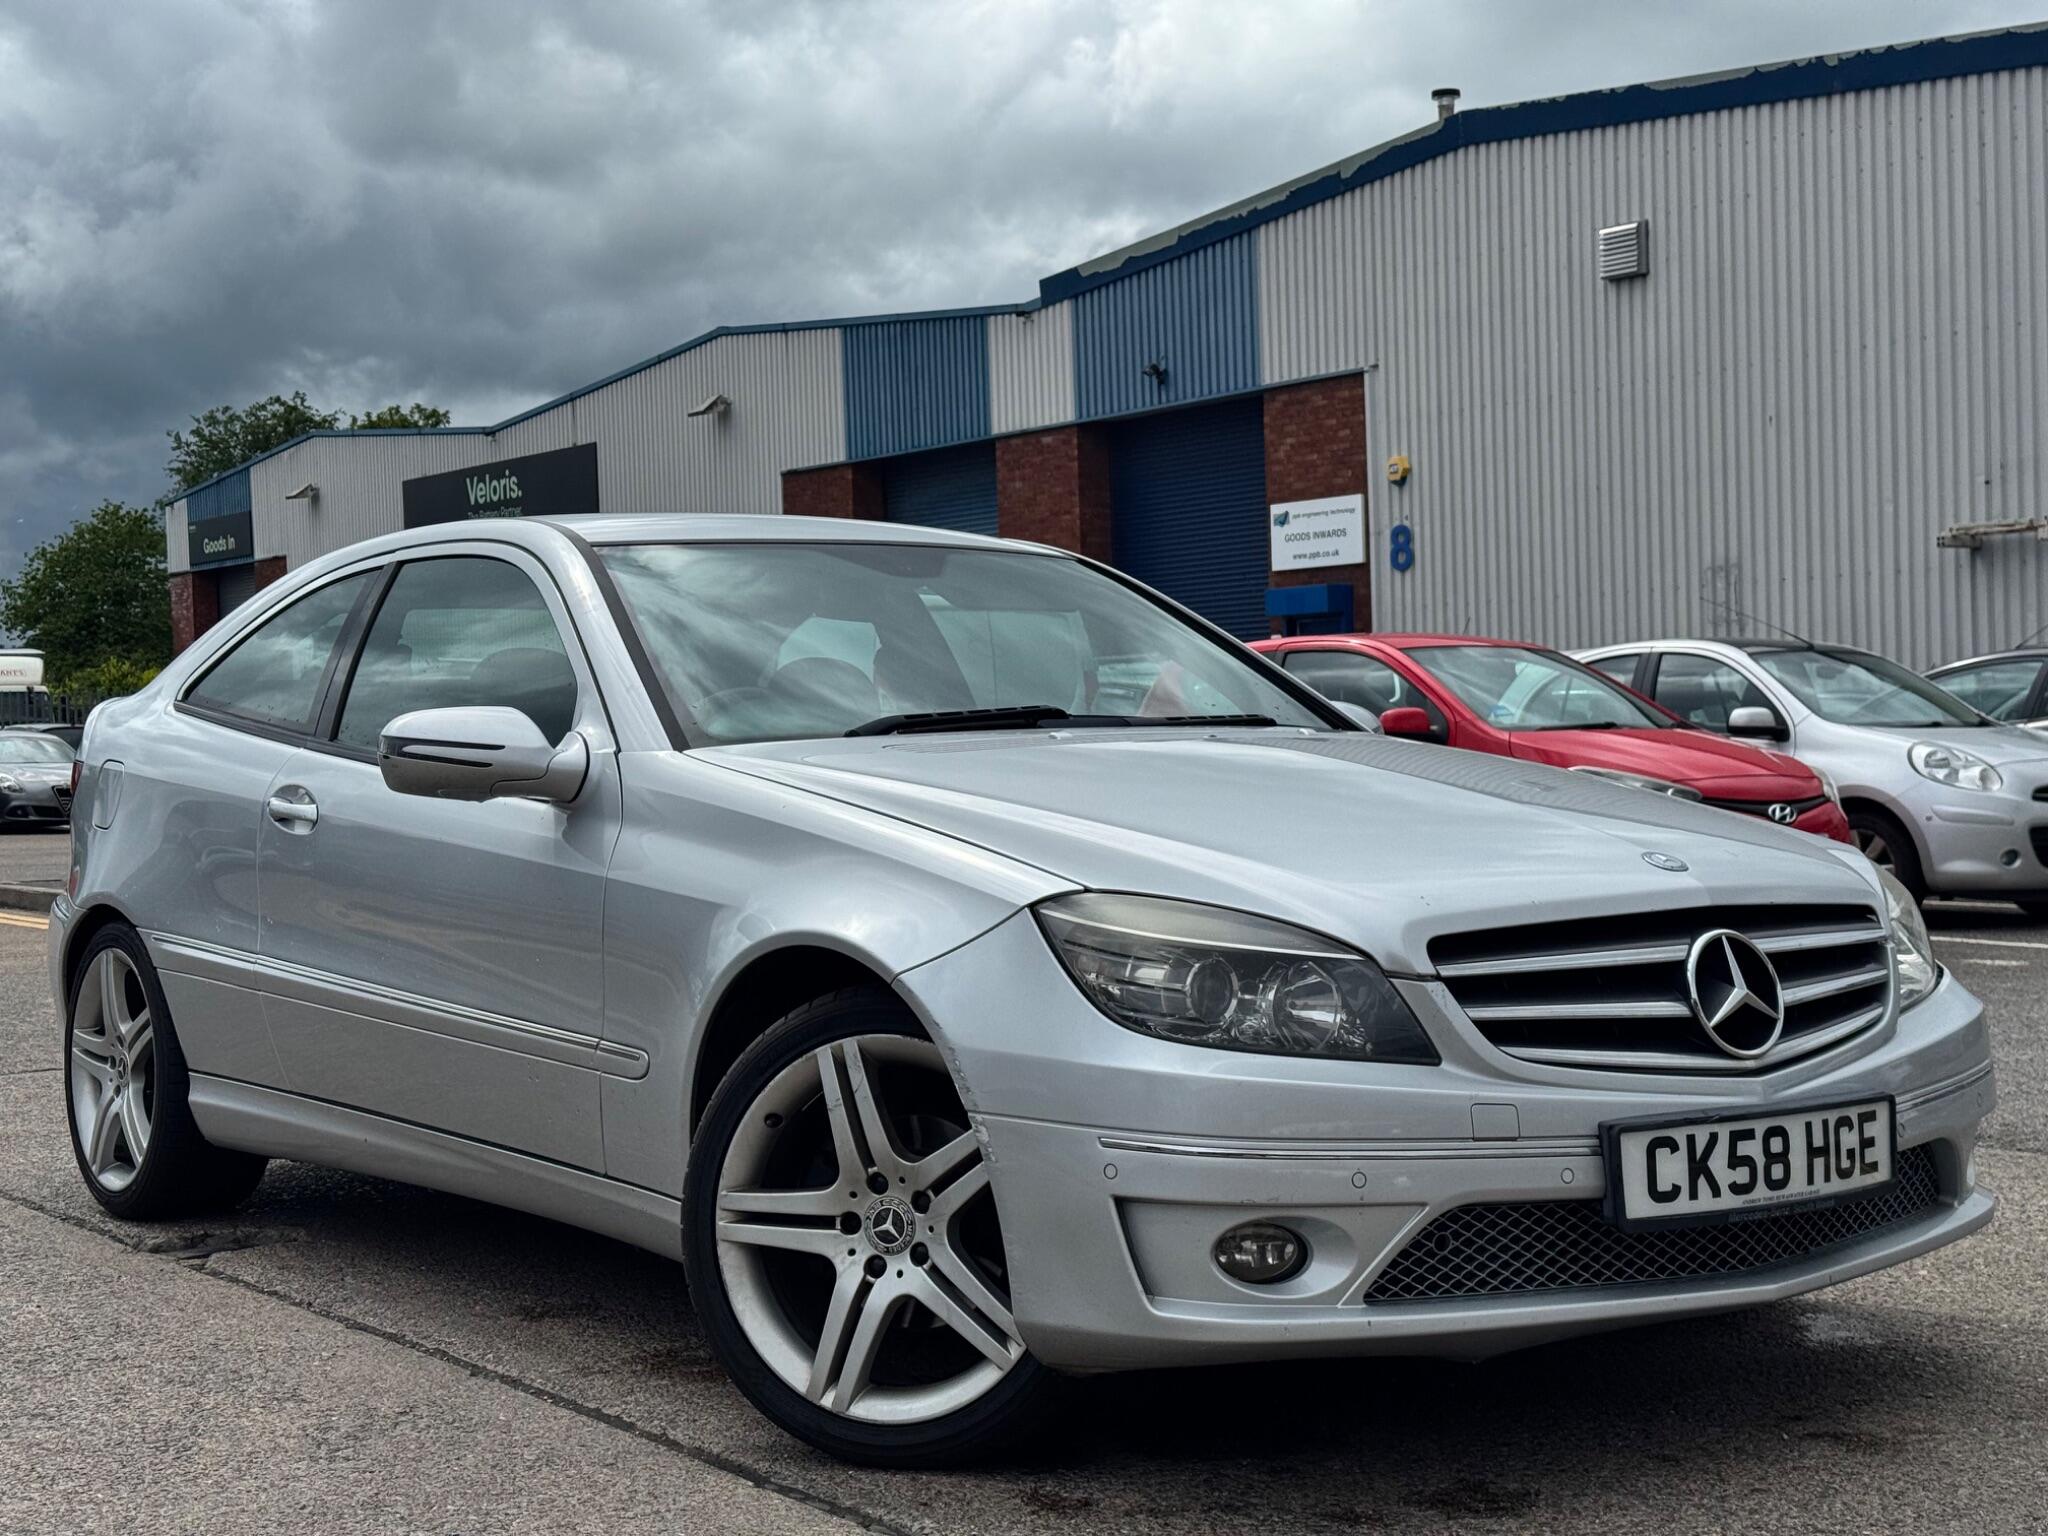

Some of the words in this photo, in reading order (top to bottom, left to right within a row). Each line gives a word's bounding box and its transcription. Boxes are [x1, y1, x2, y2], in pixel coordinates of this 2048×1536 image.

[466, 469, 522, 505] Veloris.
[203, 536, 227, 554] Goods
[227, 534, 236, 551] In
[1284, 531, 1311, 542] GOODS
[1312, 528, 1347, 540] INWARDS
[1390, 524, 1413, 572] 8
[1292, 549, 1339, 560] www.ppb.co.uk
[1645, 1124, 1791, 1204] CK58
[1804, 1109, 1879, 1187] HGE
